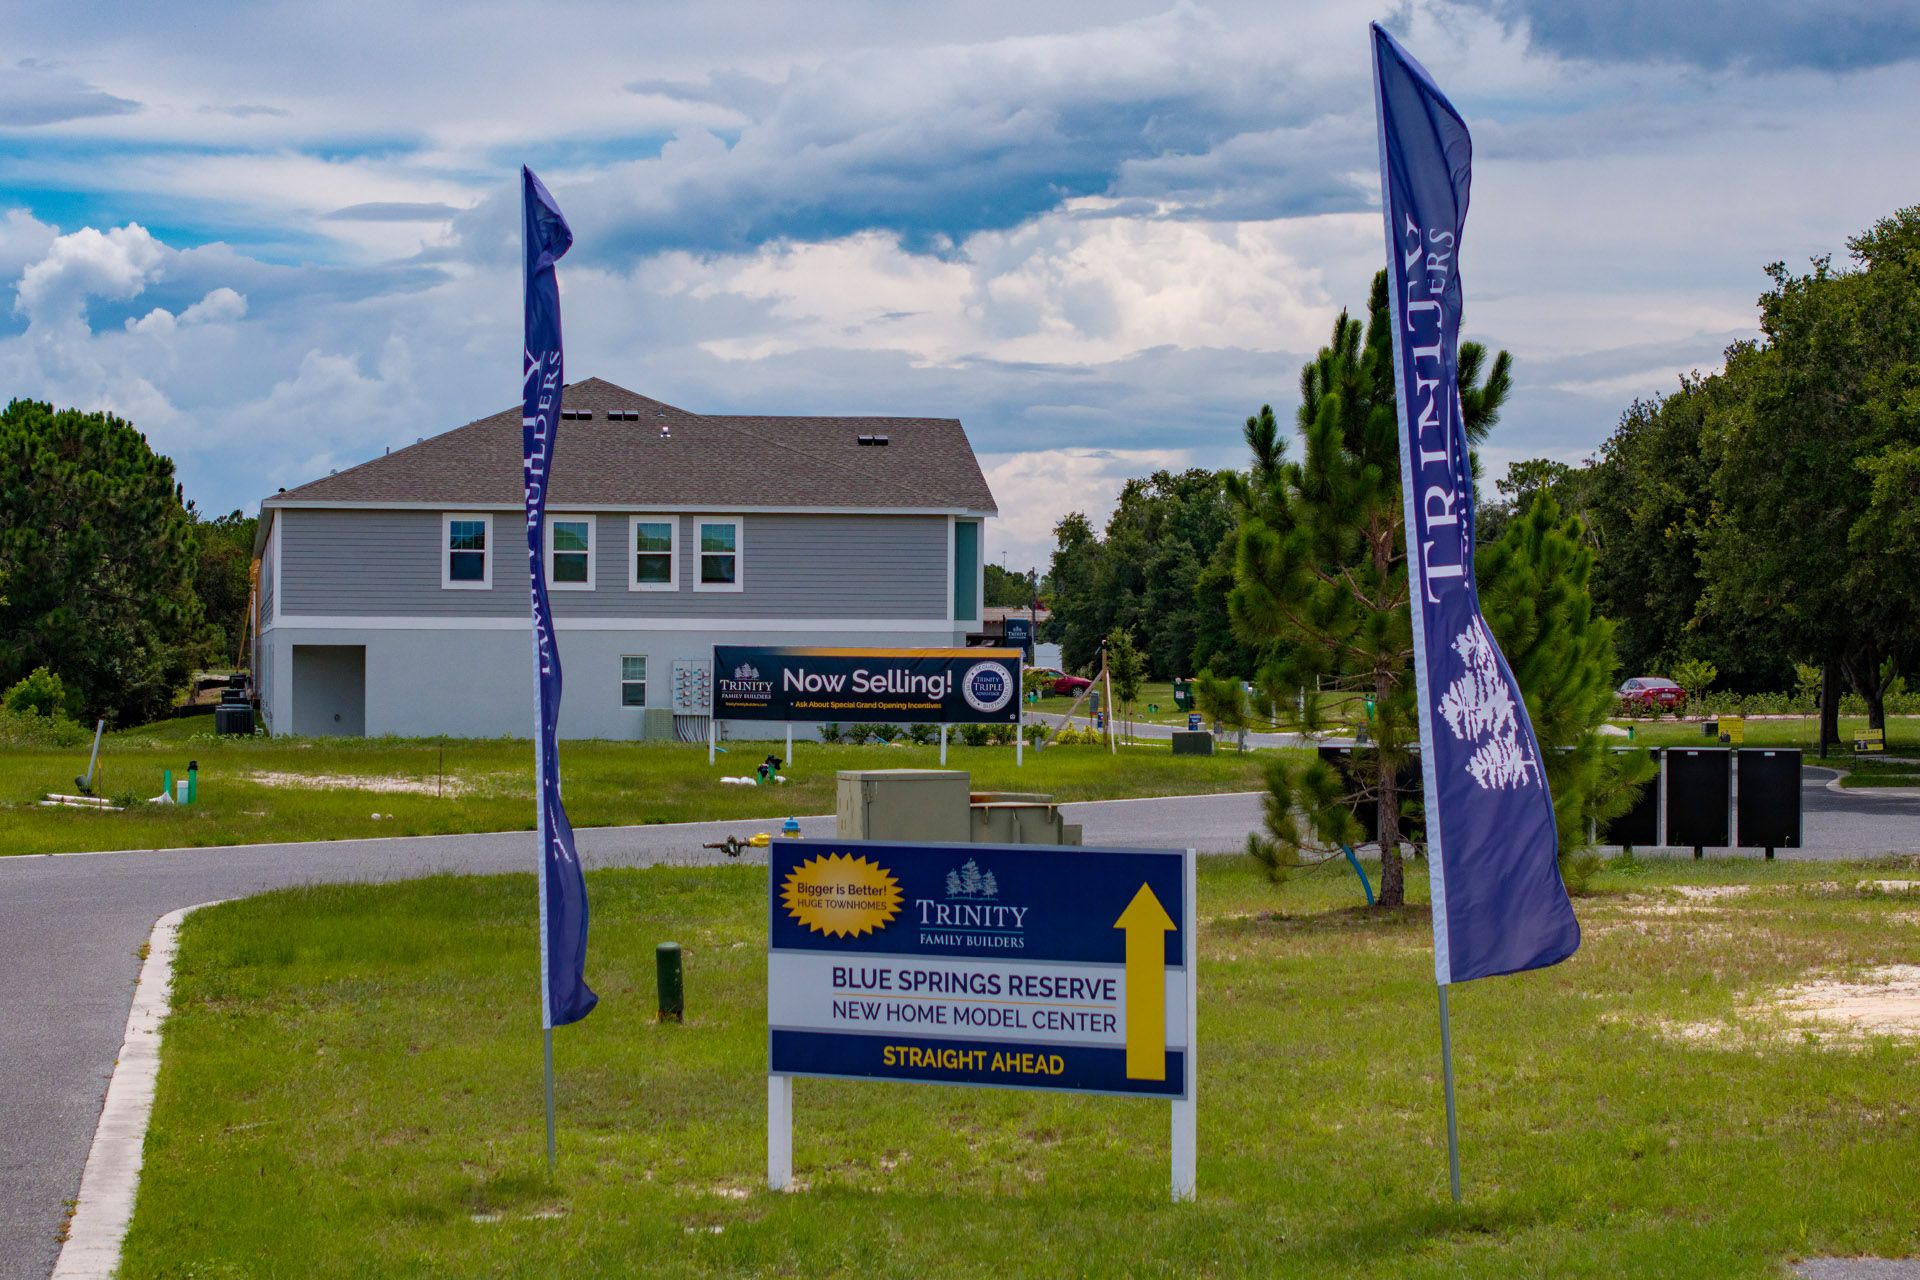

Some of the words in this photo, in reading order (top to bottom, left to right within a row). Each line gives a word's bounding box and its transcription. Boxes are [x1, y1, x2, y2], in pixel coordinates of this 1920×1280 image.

[1405, 213, 1464, 604] TRINITY
[719, 679, 774, 691] TRINITY
[783, 668, 847, 693] Now
[852, 669, 952, 700] Selling!
[973, 682, 1003, 691] TRIPLE
[830, 701, 855, 710] Special
[878, 702, 906, 710] Opening
[797, 882, 834, 897] Bigger
[836, 883, 846, 895] is
[848, 884, 888, 896] Better!
[797, 898, 823, 909] HUGE
[825, 899, 888, 911] TOWNHOMES
[915, 899, 1029, 928] TRINITY
[920, 933, 963, 946] FAMILY
[966, 935, 1025, 949] BUILDERS
[832, 967, 893, 990] BLUE
[898, 970, 1002, 995] SPRINGS
[1008, 975, 1117, 1001] RESERVE
[832, 1001, 882, 1020] NEW
[886, 1003, 948, 1025] HOME
[953, 1007, 1028, 1029] MODEL
[1032, 1010, 1117, 1033] CENTER
[882, 1046, 987, 1072] STRAIGHT
[991, 1052, 1065, 1076] AHEAD
